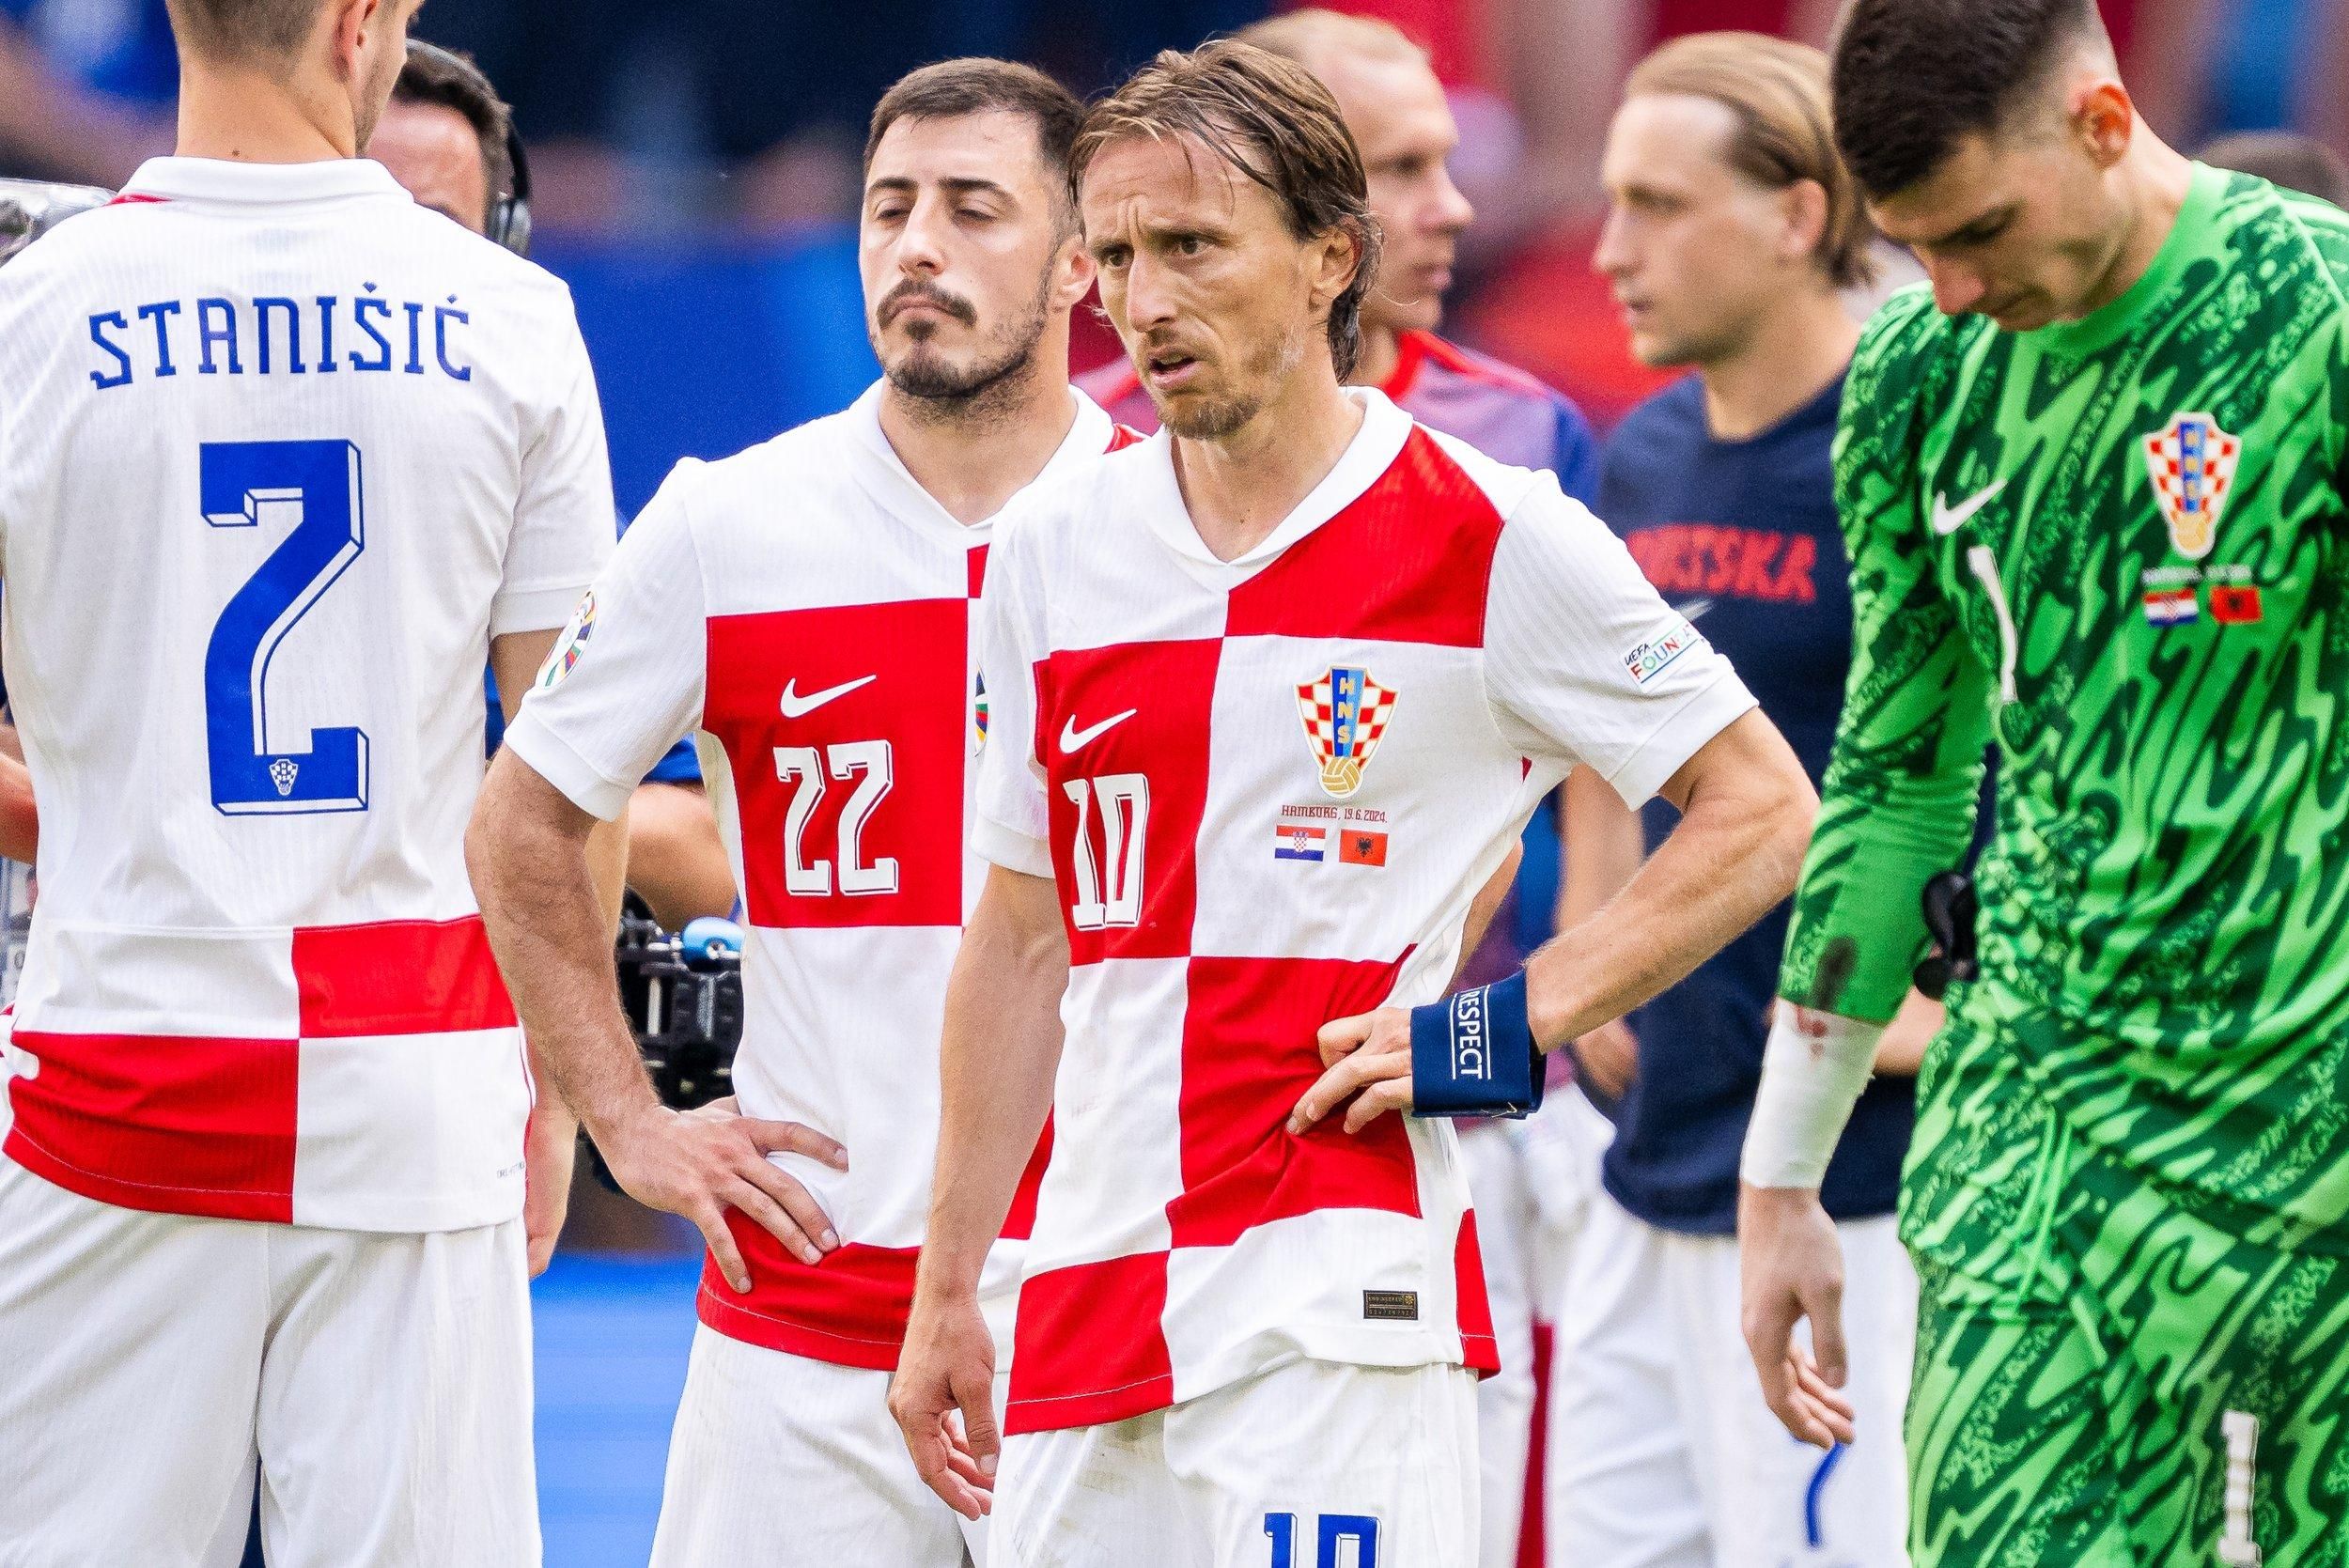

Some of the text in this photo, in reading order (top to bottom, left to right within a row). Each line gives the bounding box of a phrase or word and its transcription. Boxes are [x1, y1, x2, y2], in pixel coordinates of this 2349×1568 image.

[199, 439, 369, 816] 2
[1625, 643, 1651, 666] UEFA
[773, 738, 898, 896] 22
[1063, 772, 1150, 931] 10
[1457, 990, 1484, 1079] RESPECT
[2217, 1409, 2263, 1568] 1
